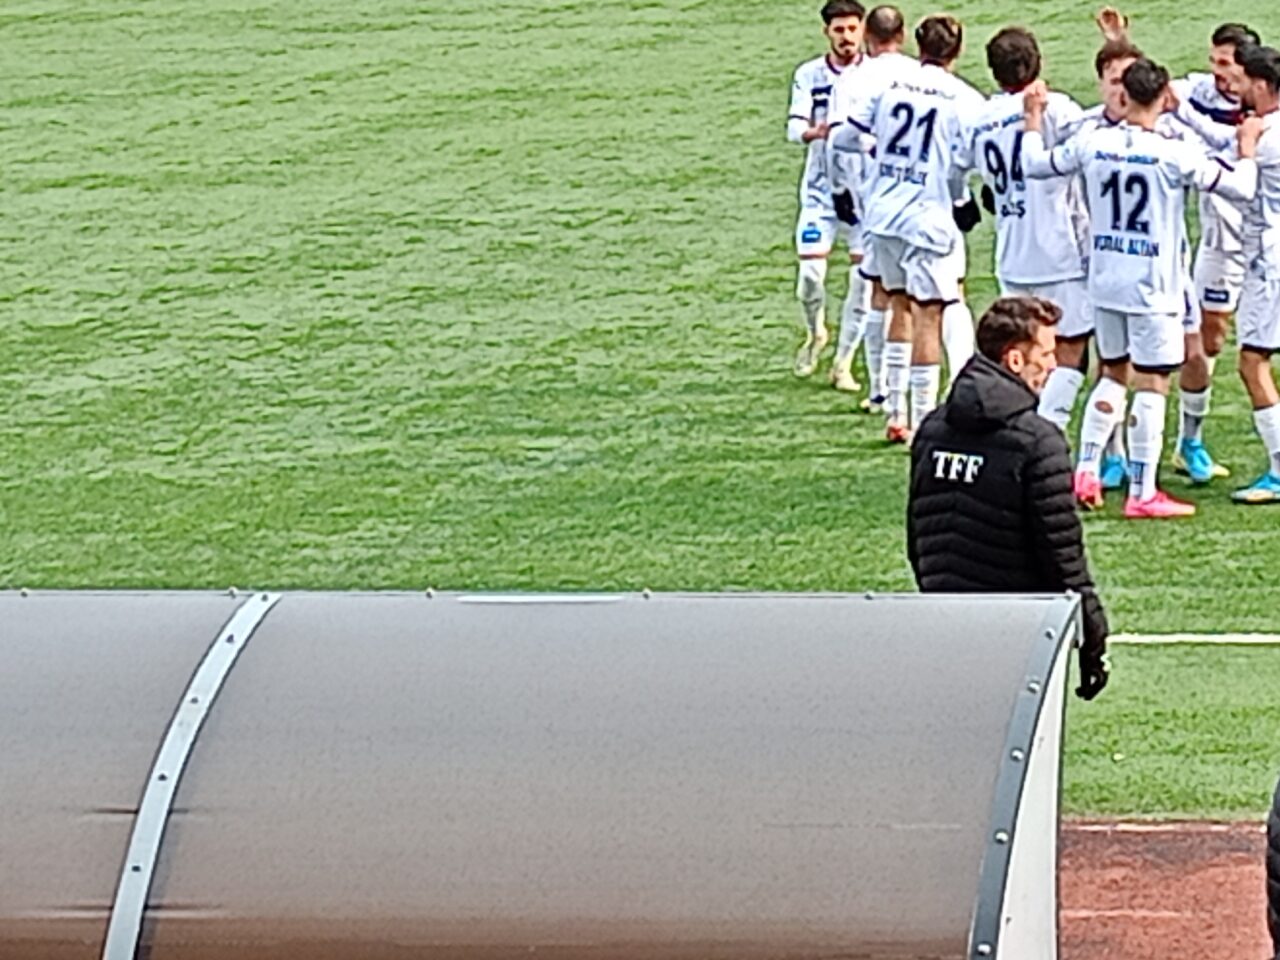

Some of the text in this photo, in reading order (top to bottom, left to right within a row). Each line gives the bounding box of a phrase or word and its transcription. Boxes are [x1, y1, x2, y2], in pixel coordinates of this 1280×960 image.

[884, 101, 938, 163] 21
[1100, 169, 1150, 235] 12
[932, 451, 984, 483] TFF
